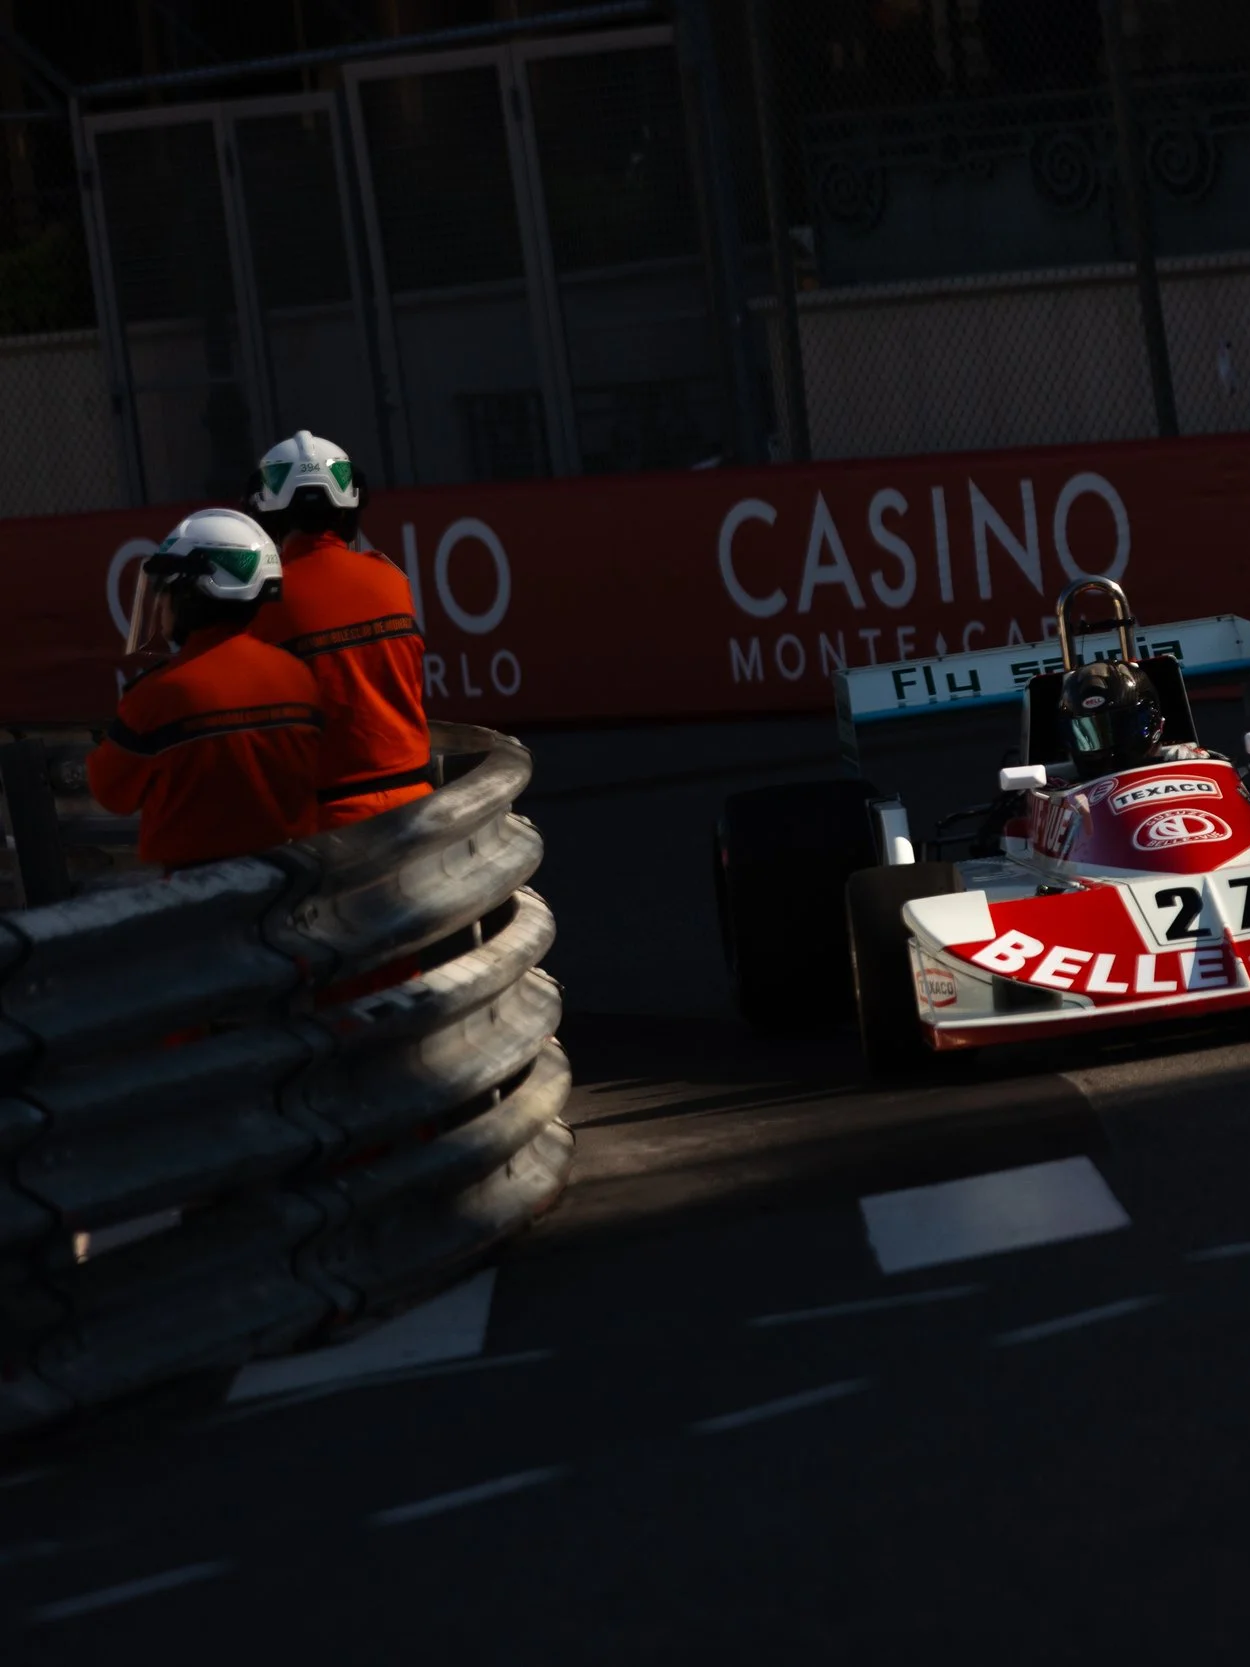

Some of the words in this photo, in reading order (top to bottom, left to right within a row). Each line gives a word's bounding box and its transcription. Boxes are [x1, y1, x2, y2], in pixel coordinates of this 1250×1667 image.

[718, 471, 1131, 618] CASINO
[892, 665, 981, 702] Fly
[1116, 783, 1213, 804] TEXACO
[970, 929, 1229, 993] BELLE
